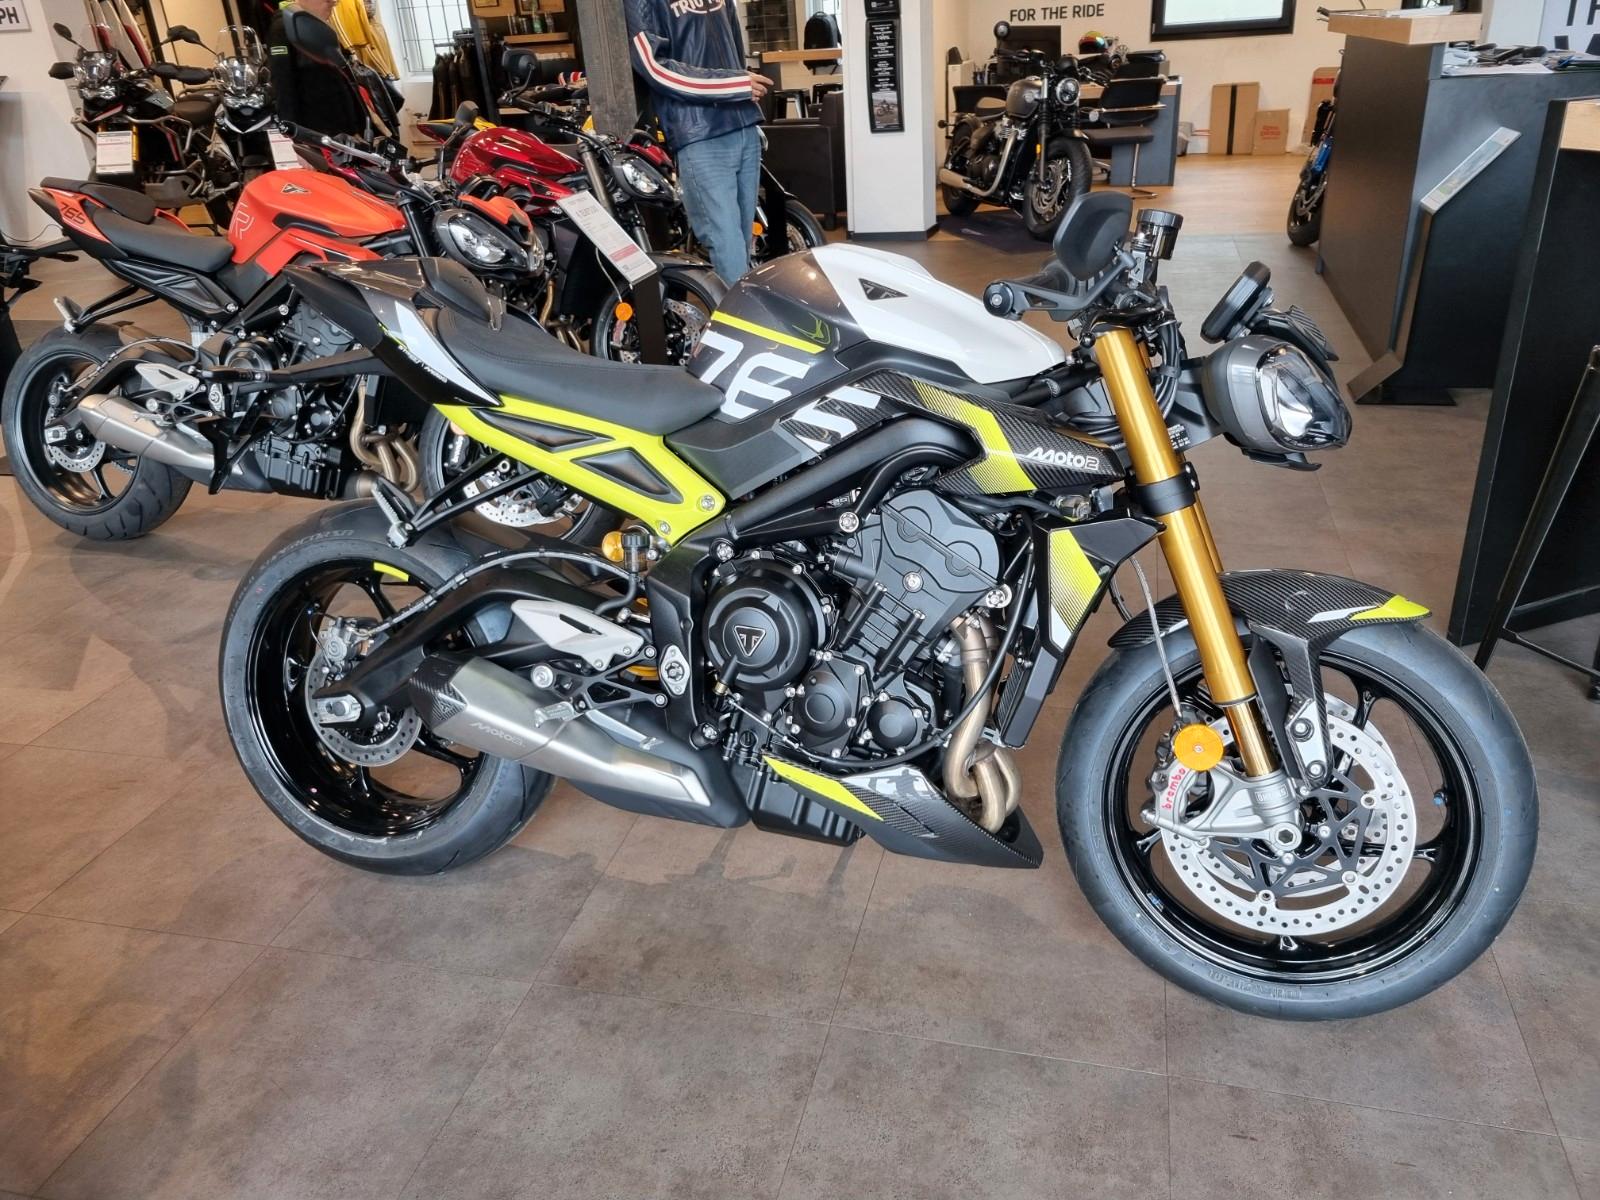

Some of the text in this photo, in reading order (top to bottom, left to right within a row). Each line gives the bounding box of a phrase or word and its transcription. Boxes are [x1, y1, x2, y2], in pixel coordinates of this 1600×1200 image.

[1009, 3, 1105, 22] FOR THE RIDE
[1161, 767, 1186, 810] brembo
